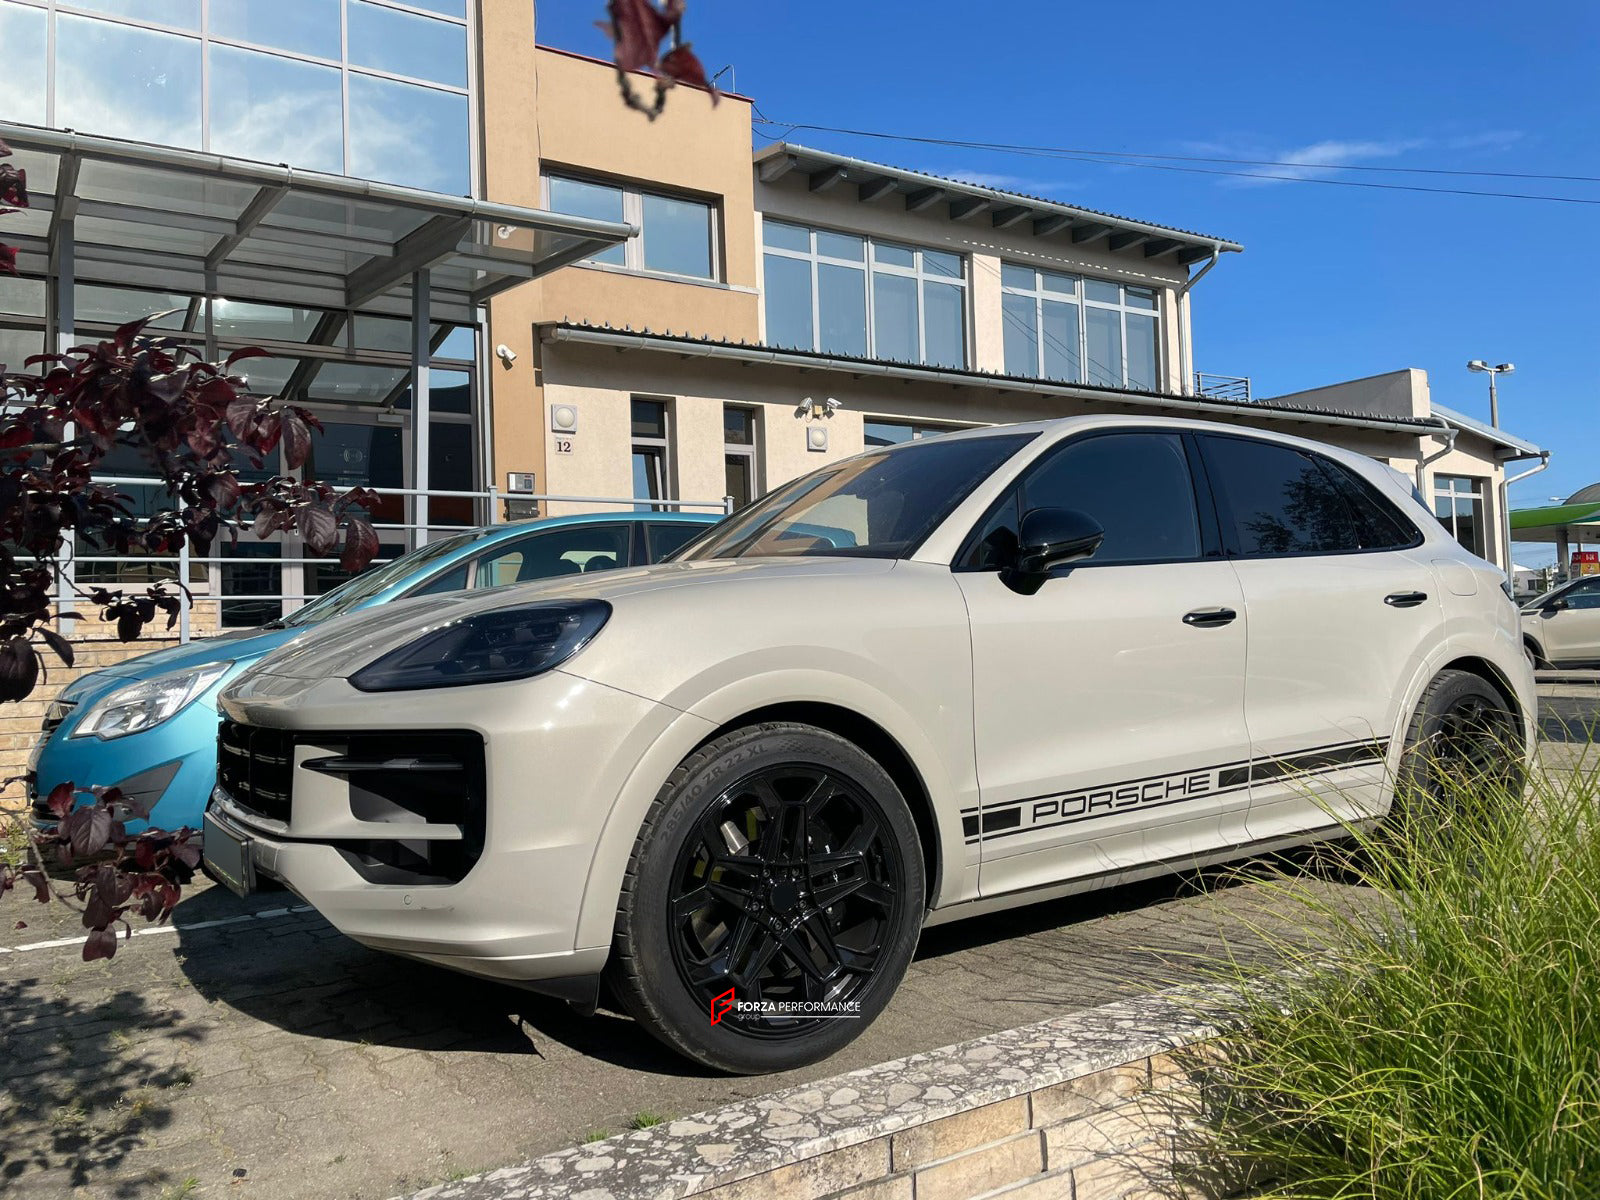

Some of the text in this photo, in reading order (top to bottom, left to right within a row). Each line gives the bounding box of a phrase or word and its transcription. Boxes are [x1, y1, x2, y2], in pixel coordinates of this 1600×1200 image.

[556, 441, 572, 453] 12
[660, 743, 769, 842] 285/40 ZR 22 XL
[1032, 774, 1211, 823] PORSCHE
